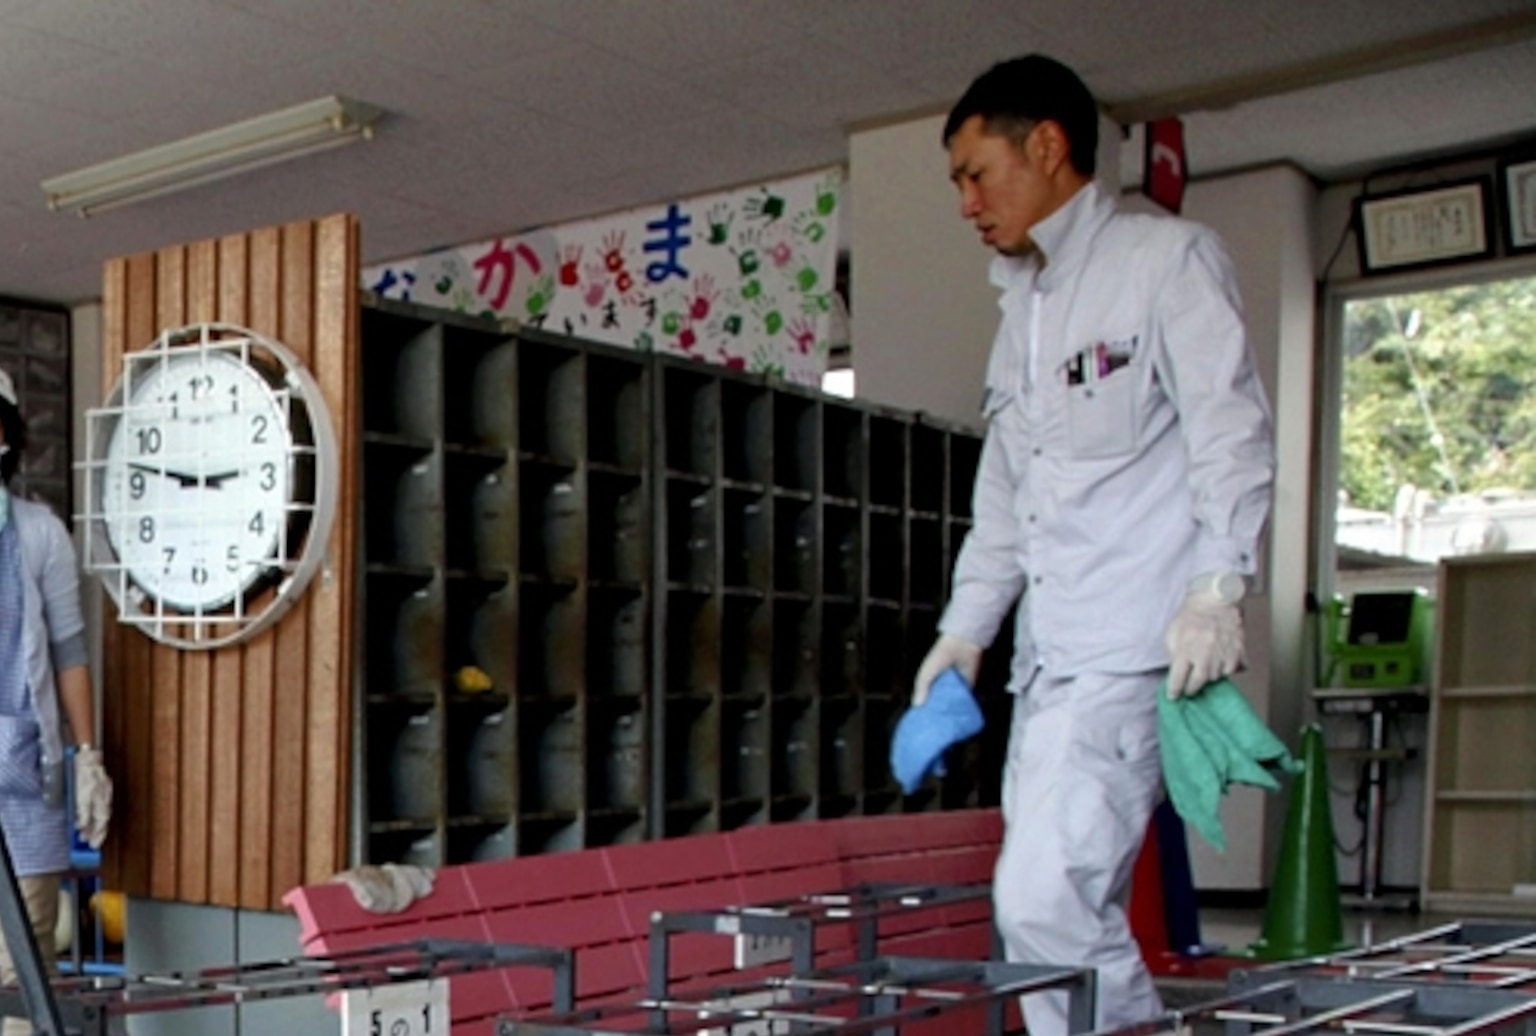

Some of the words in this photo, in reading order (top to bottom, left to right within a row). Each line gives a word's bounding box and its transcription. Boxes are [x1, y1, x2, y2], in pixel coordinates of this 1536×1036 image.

[136, 427, 162, 455] 10
[251, 415, 268, 444] 2
[129, 472, 146, 500] 9
[260, 463, 276, 491] 3
[139, 515, 155, 543] 8
[248, 510, 264, 537] 4
[163, 547, 177, 575] 7
[226, 545, 239, 572] 5
